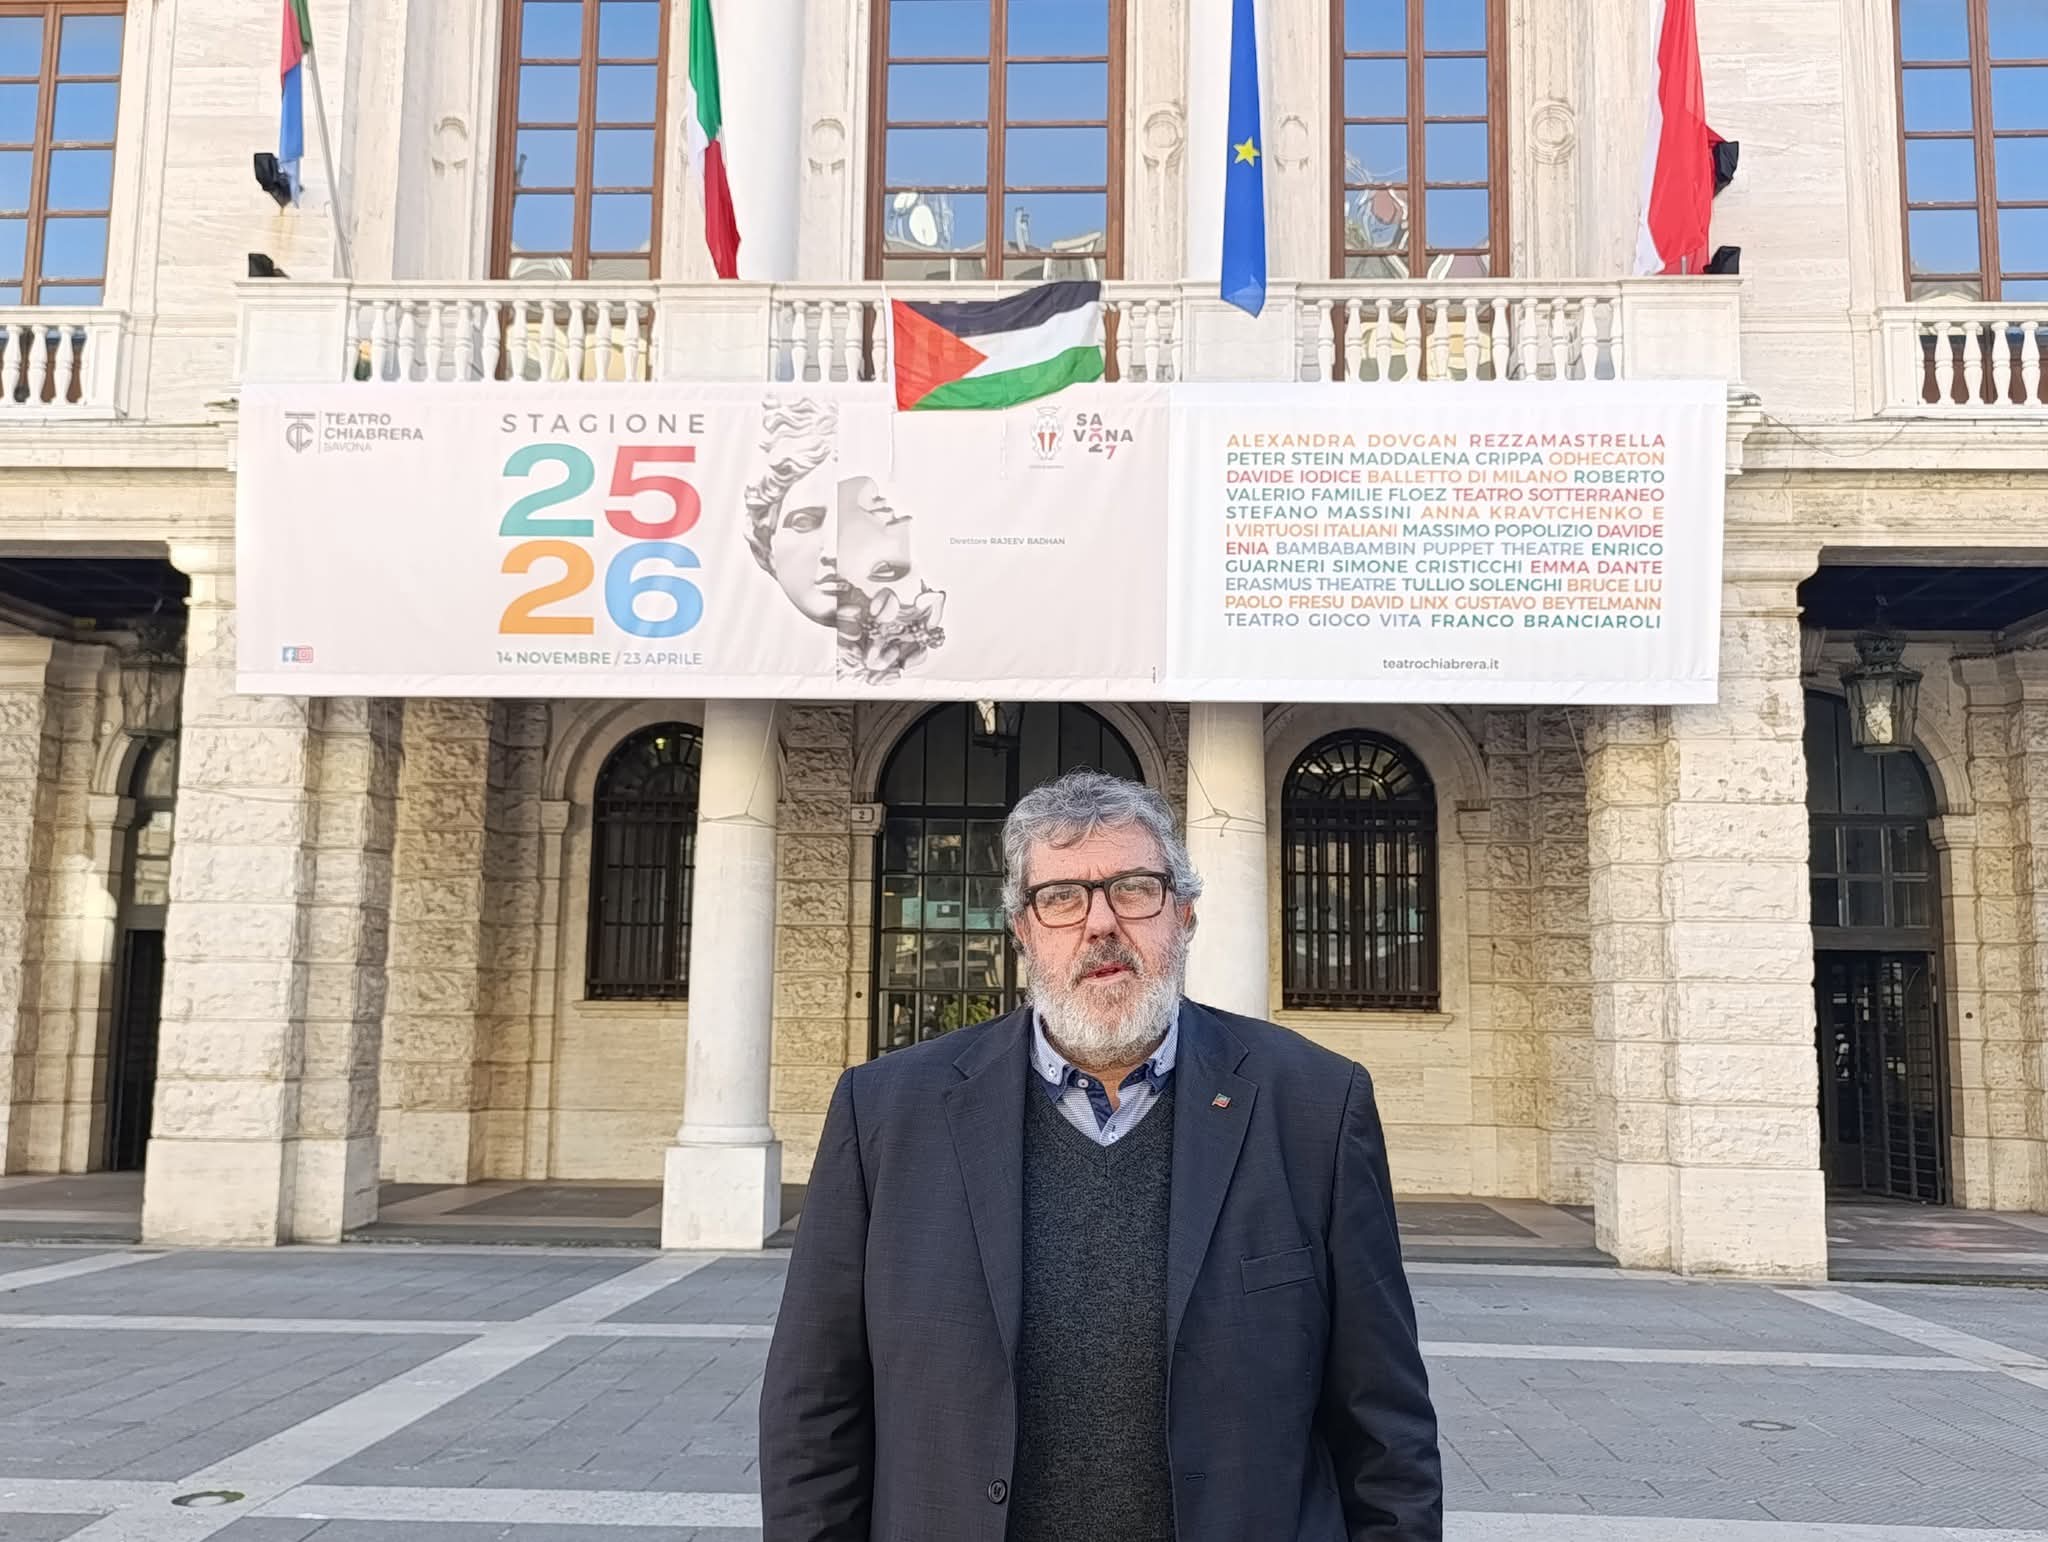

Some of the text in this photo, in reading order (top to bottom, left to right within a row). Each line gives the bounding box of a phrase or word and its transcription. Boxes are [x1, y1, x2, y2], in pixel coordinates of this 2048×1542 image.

[325, 412, 392, 426] TEATRO
[500, 413, 705, 434] STAGIONE
[1076, 413, 1103, 426] SA
[324, 427, 424, 441] CHIABRERA
[1227, 434, 1666, 448] ALEXANDRA DOVGAN REZZAMASTRELLA
[1227, 452, 1665, 466] PETER STEIN MADDALENA CRIPPA ODHECATON
[1227, 470, 1665, 484] DAVIDE IODICE BALLETTO DI MILANO ROBERTO
[498, 443, 702, 540] 25
[1226, 488, 1665, 501] VALERIO FAMILIE FLOEZ TEATRO SOTTERRANEO
[1226, 506, 1664, 520] STEFANO MASSINI ANNA KRAVTCHENKO E
[1226, 524, 1663, 538] I VIRTUOSI ITALIANI MASSIMO POPOLIZIO DAVIDE
[1226, 541, 1663, 556] ENIA BAMBABAMBIN PUPPET THEATRE ENRICO
[1225, 559, 1663, 574] GUARNERI SIMONE CRISTICCHI EMMA DANTE
[498, 540, 704, 639] 26
[1226, 577, 1662, 593] ERASMUS THEATRE TULLIO SOLENGHI BRUCE LIU
[1224, 595, 1662, 610] PAOLO FRESU DAVID LINX GUSTAVO BEYTELMANN
[1224, 613, 1661, 629] TEATRO GIOCO VITA FRANCO BRANCIAROLI
[496, 651, 513, 665] 14
[516, 651, 612, 666] NOVEMBRE
[623, 651, 642, 666] 23
[644, 652, 704, 667] APRILE
[1383, 657, 1499, 670] teatrochiabrera.it
